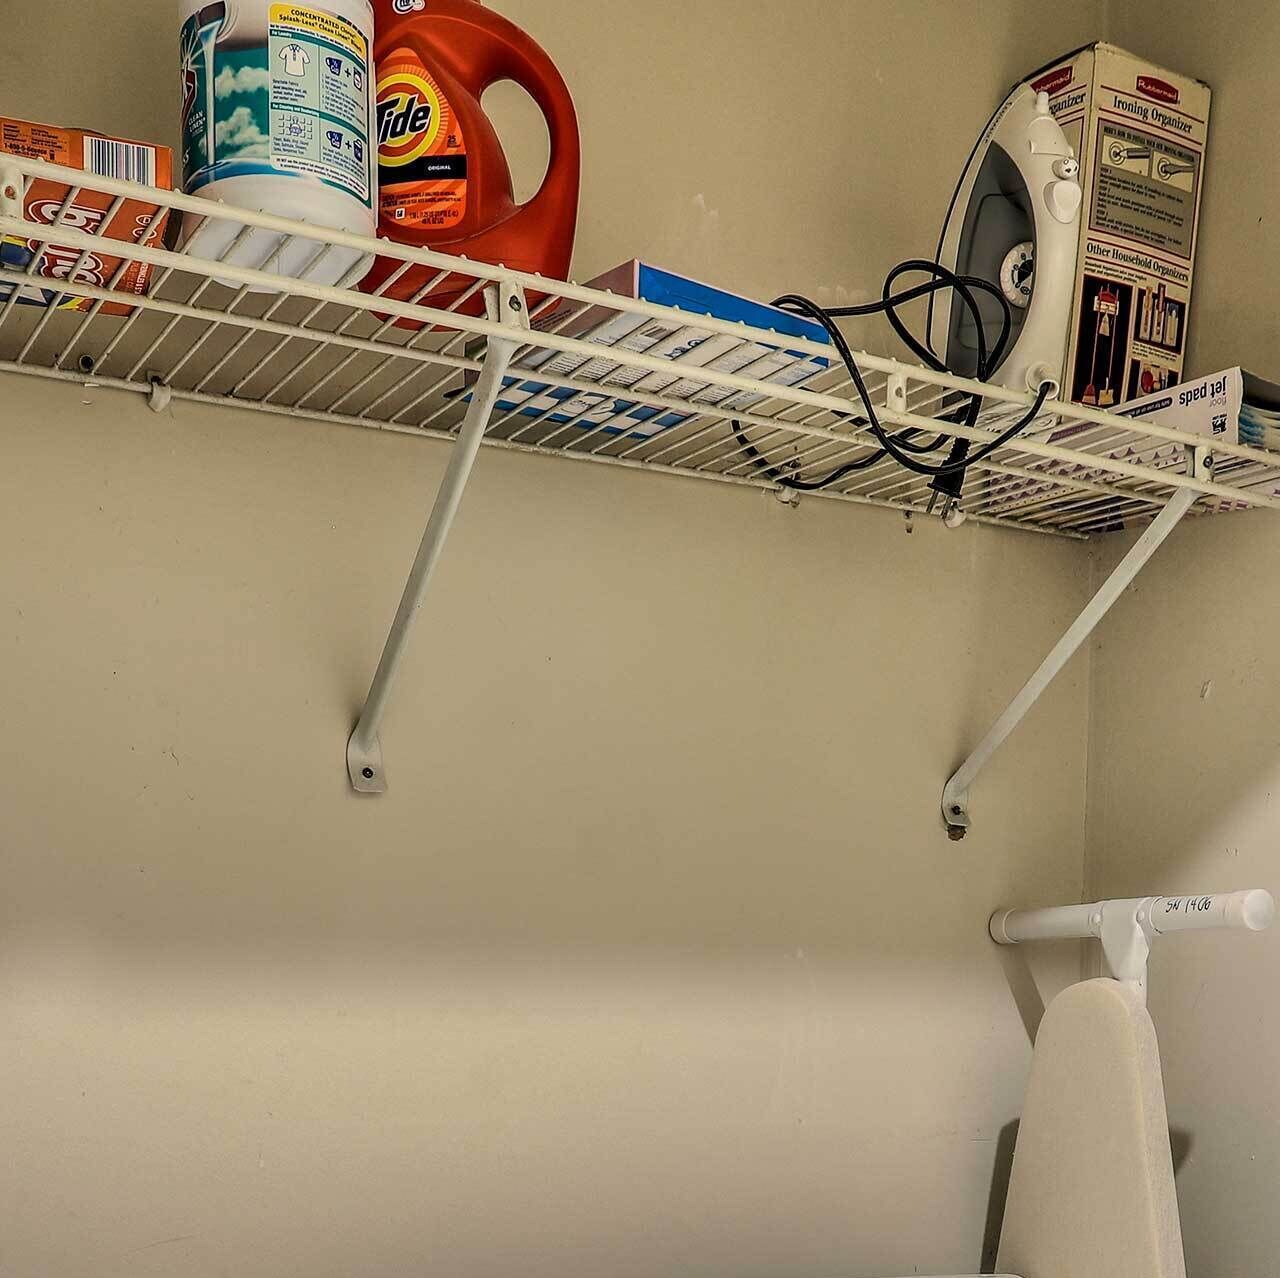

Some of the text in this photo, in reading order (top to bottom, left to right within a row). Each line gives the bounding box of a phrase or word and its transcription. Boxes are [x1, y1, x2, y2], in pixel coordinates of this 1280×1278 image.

[291, 9, 340, 29] CONCENTRATED
[319, 24, 334, 34] Clean
[1138, 79, 1177, 102] Rubbermaid
[1049, 92, 1086, 116] ganizer
[188, 110, 203, 125] CLEAN
[376, 94, 432, 145] Tide
[1113, 96, 1192, 134] Ironing Organizer
[428, 164, 451, 172] ORIGINAL
[1087, 243, 1111, 257] Other
[1112, 248, 1152, 270] Household
[1154, 260, 1189, 282] Organizers
[1179, 376, 1227, 407] jet pads
[1210, 396, 1227, 407] floor
[1185, 896, 1212, 913] 1406
